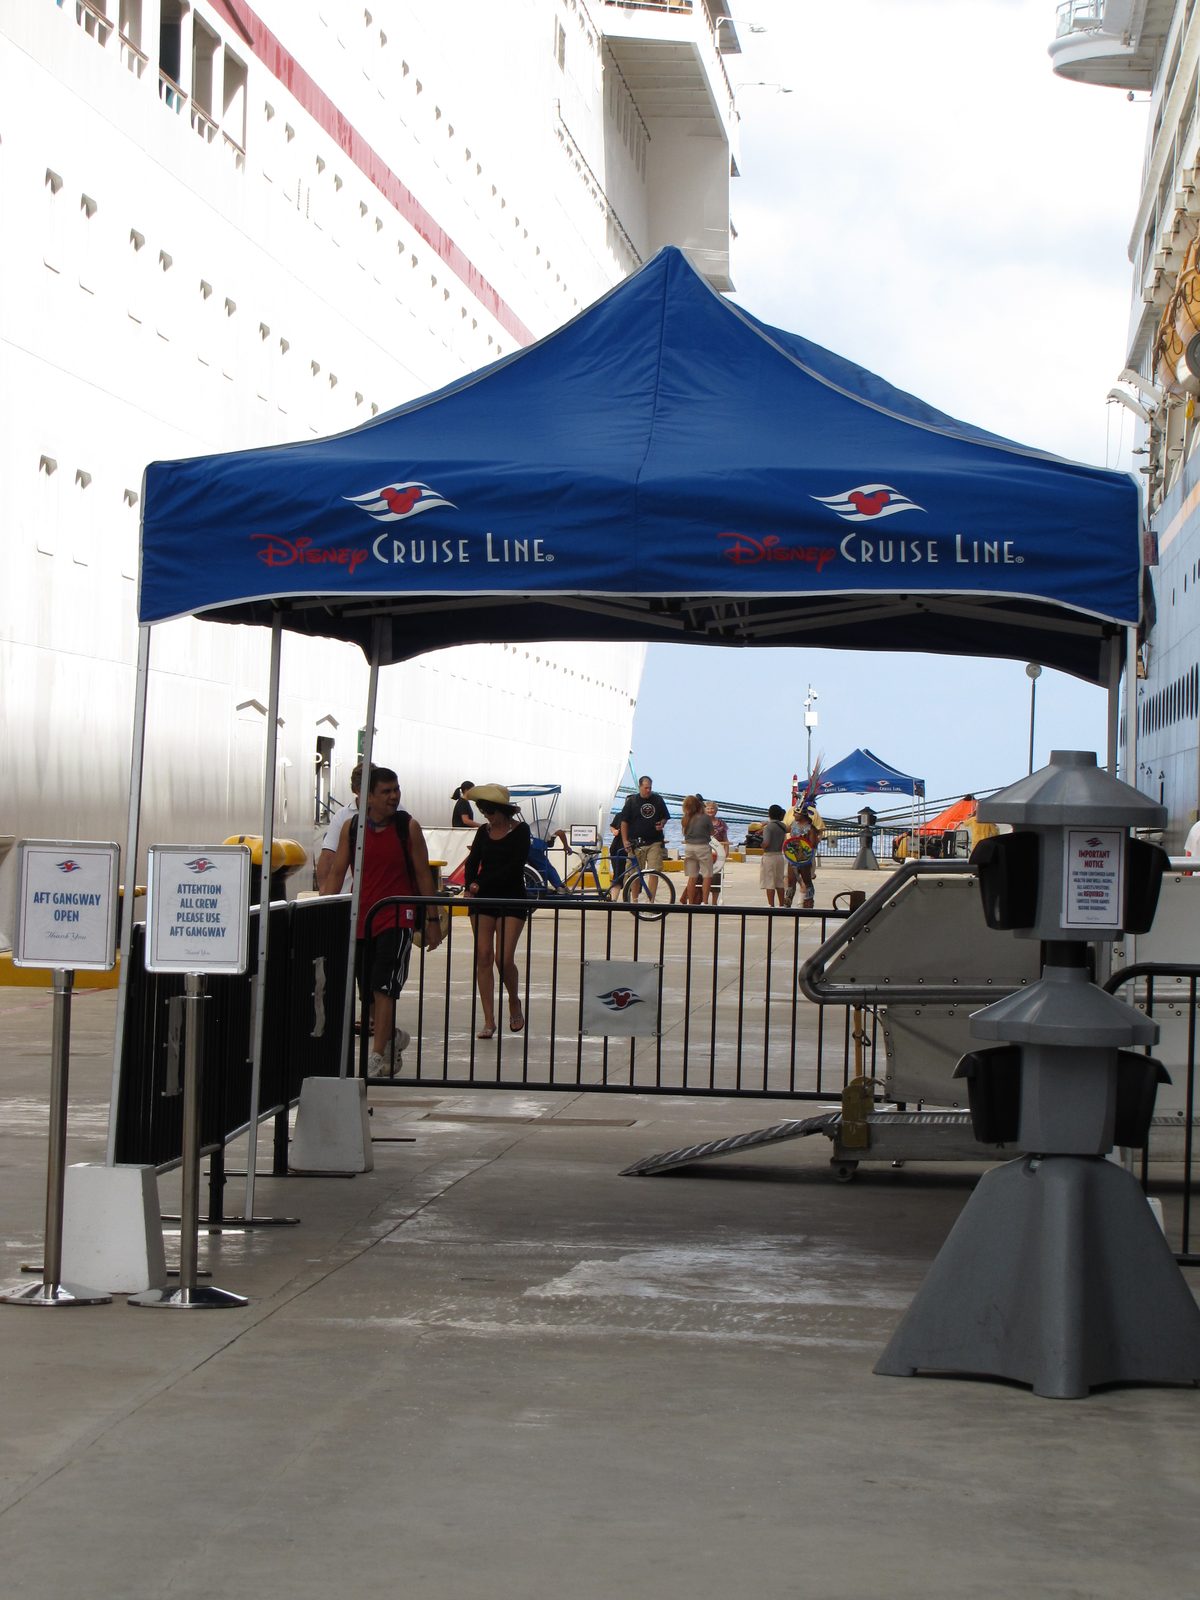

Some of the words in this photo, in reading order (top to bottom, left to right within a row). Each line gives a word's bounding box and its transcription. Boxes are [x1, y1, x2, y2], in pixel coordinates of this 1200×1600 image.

[250, 533, 368, 574] Disney
[372, 532, 470, 564] CRUISE
[716, 531, 836, 573] Disney
[840, 532, 939, 563] CRUISE
[1078, 850, 1111, 859] IMPORTANT
[1084, 860, 1104, 869] NOTICE
[177, 883, 222, 895] ATTENTION
[33, 891, 51, 904] AFT
[52, 892, 102, 906] GANGWAY
[179, 898, 194, 909] ALL
[195, 898, 218, 909] CREW
[54, 910, 80, 922] OPEN
[176, 912, 205, 923] PLEASE
[205, 912, 221, 923] USE
[169, 926, 185, 937] AFT
[185, 926, 226, 938] GANGWAY
